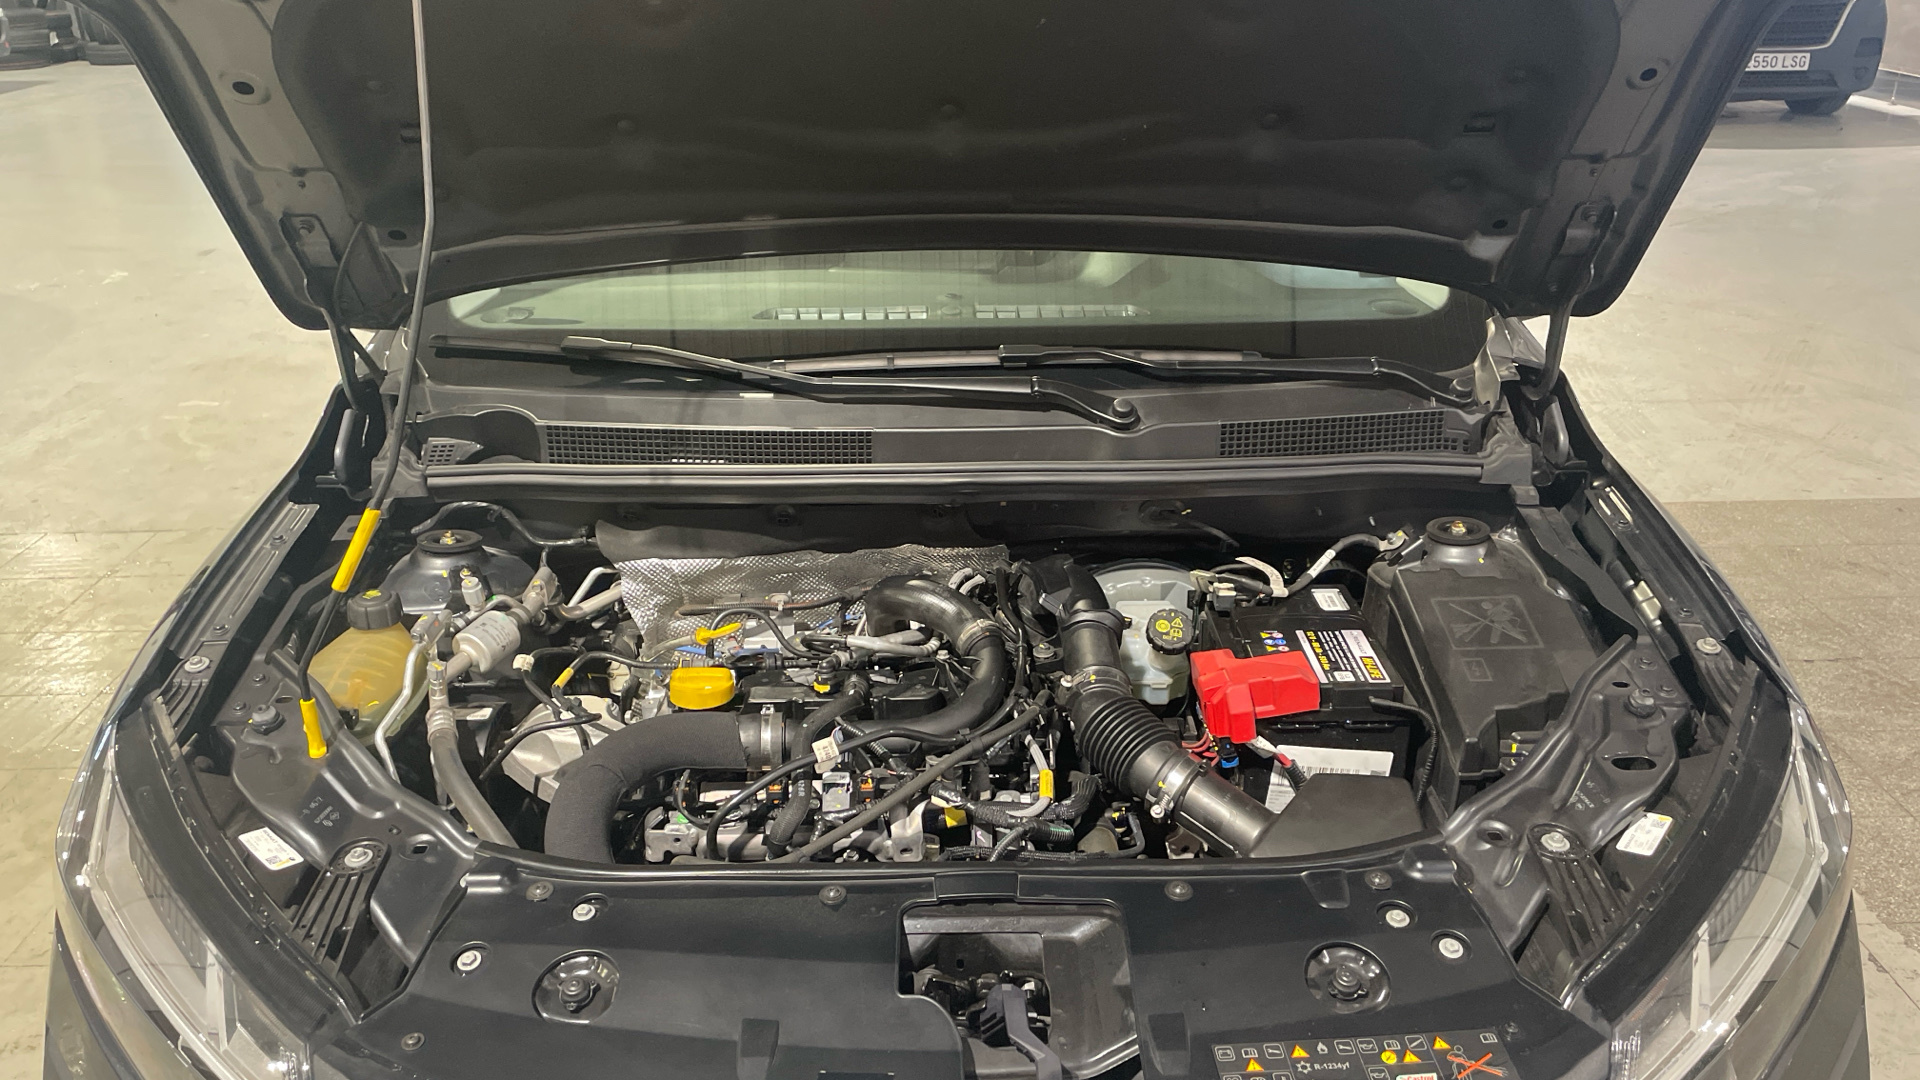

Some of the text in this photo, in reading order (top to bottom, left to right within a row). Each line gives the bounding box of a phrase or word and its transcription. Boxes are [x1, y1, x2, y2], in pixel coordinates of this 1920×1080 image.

[1748, 55, 1808, 69] 550 LSG
[1313, 1062, 1350, 1071] R-1234yf
